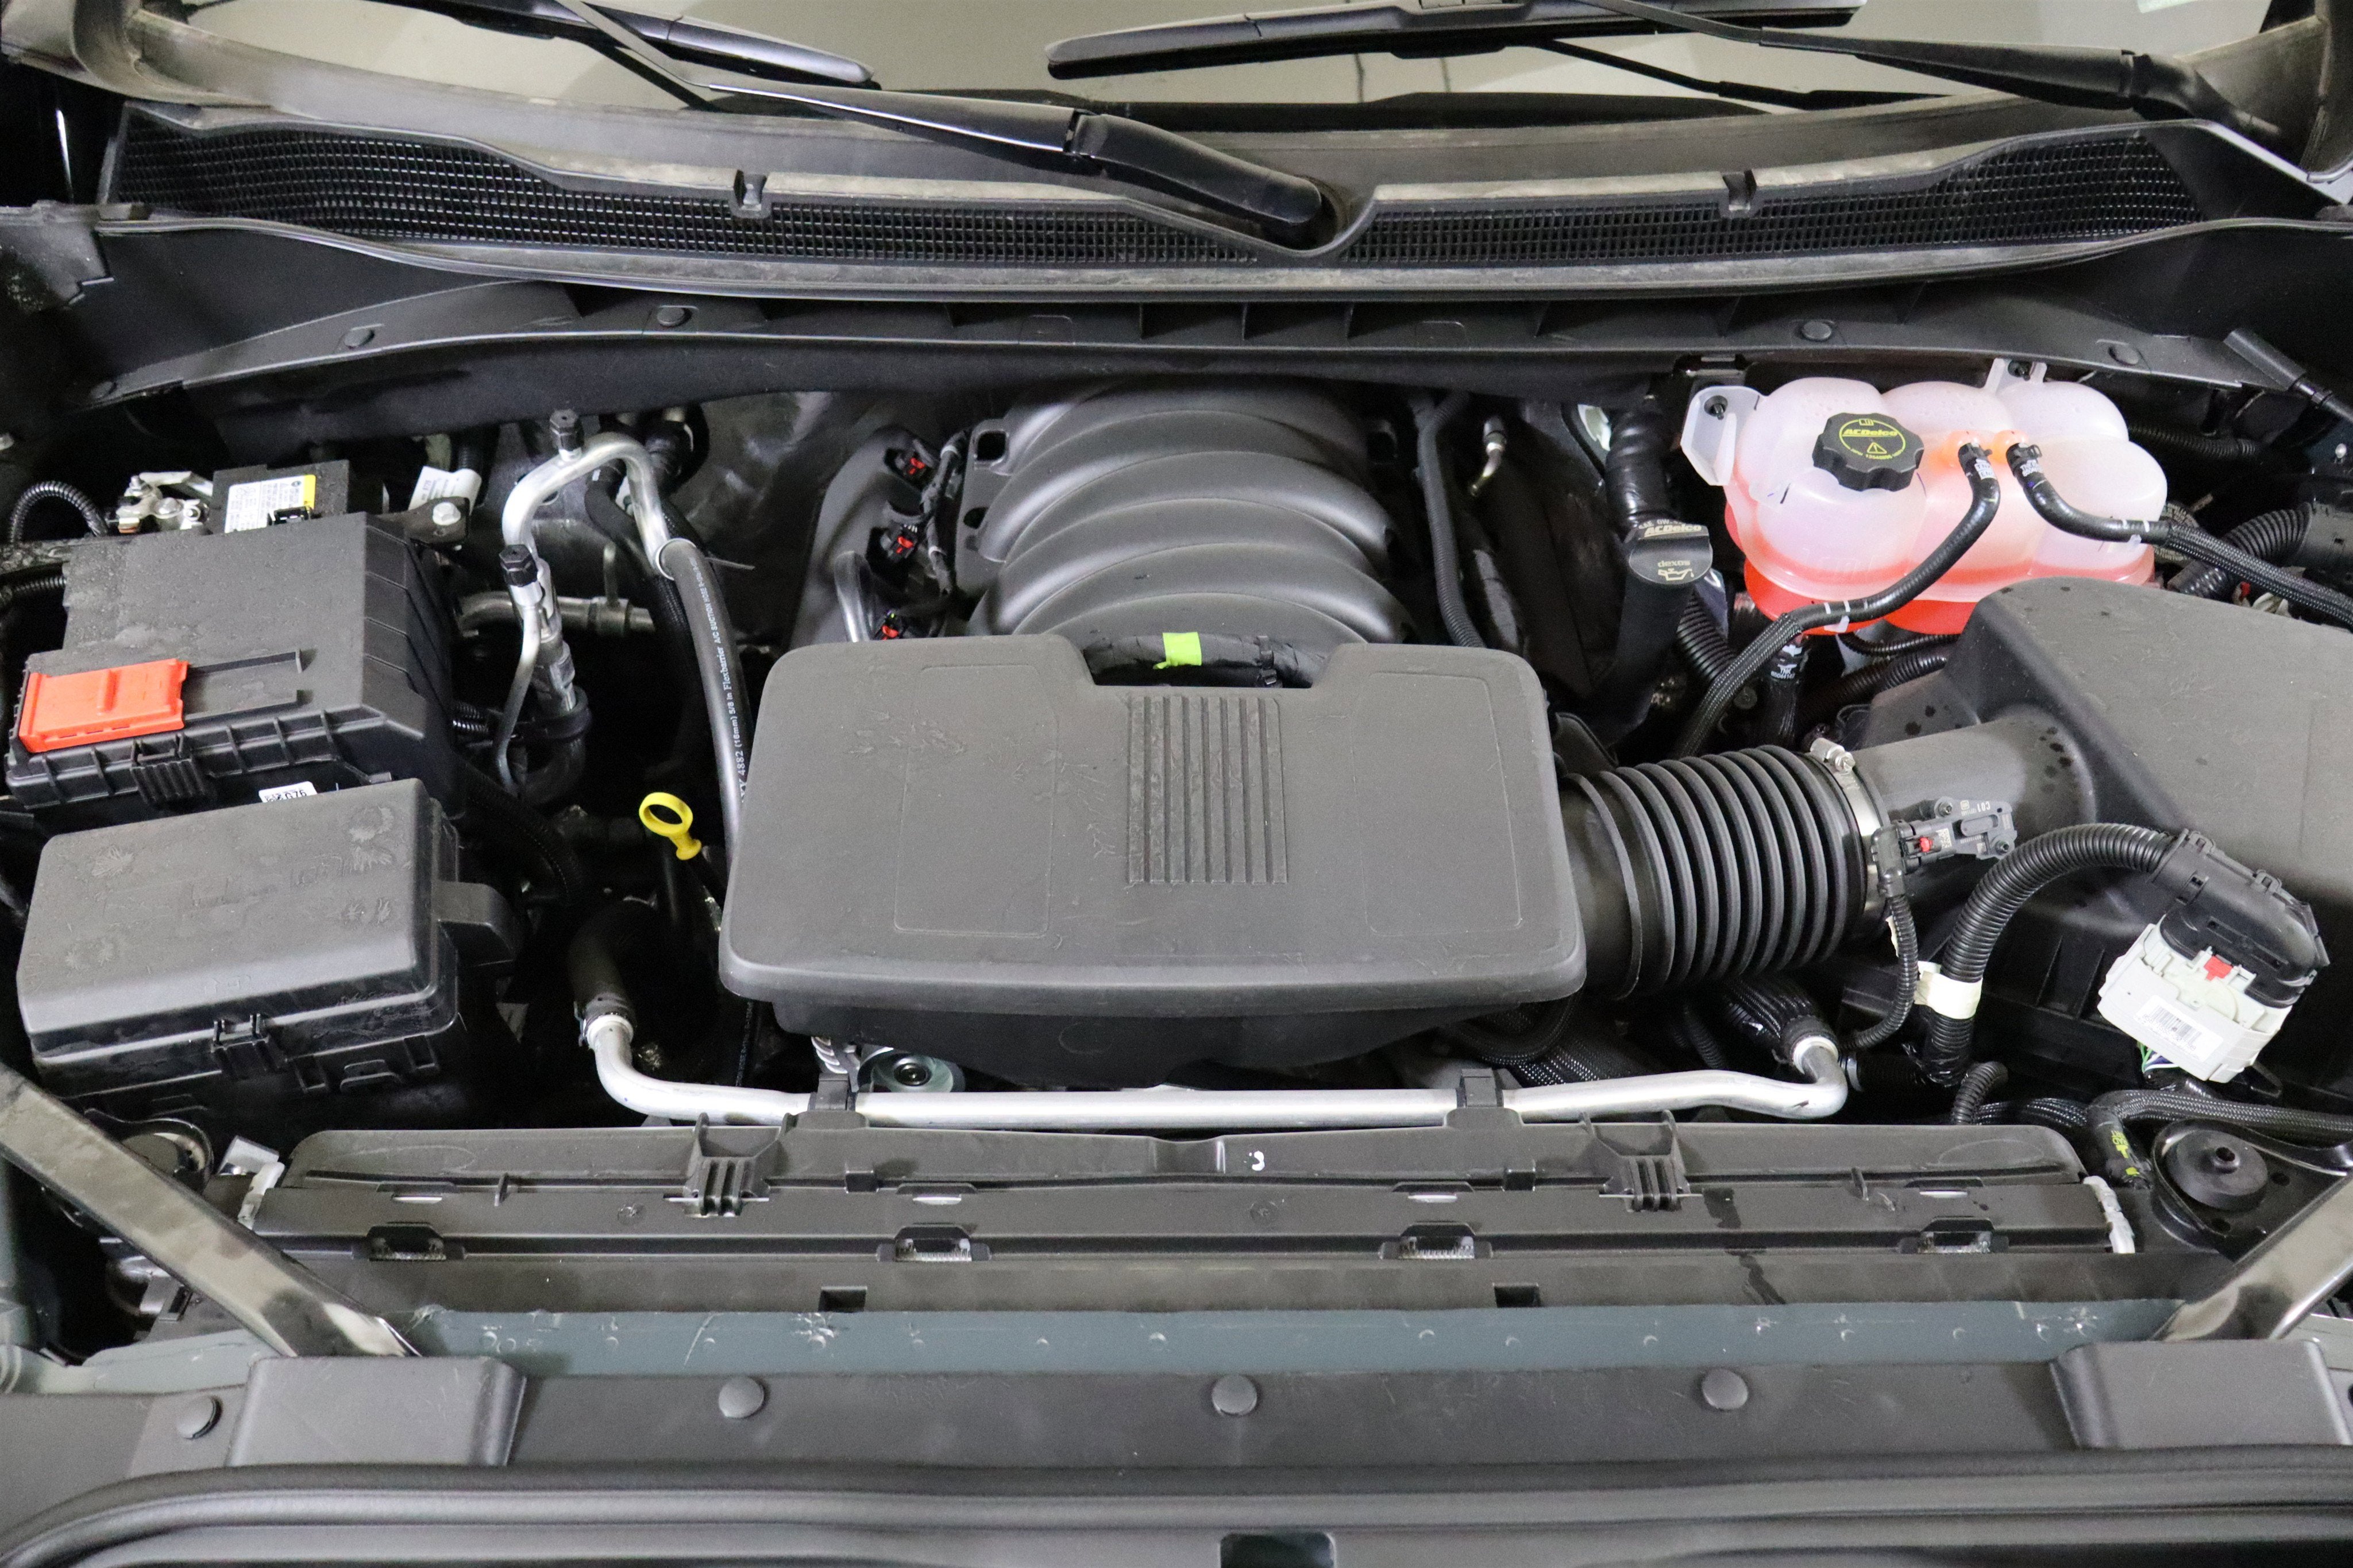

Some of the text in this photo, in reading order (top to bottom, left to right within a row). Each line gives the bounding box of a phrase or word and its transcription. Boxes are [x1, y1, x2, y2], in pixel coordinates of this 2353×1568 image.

[1842, 428, 1898, 437] ACDelco
[1644, 524, 1702, 537] ACDelco
[704, 603, 718, 631] SUCTION
[712, 631, 722, 644] A/C
[717, 646, 732, 691] Flexbarrier
[727, 702, 735, 715] 5/8
[730, 716, 742, 747] (16mm)
[735, 751, 746, 775] 4882
[1977, 801, 1991, 813] C01
